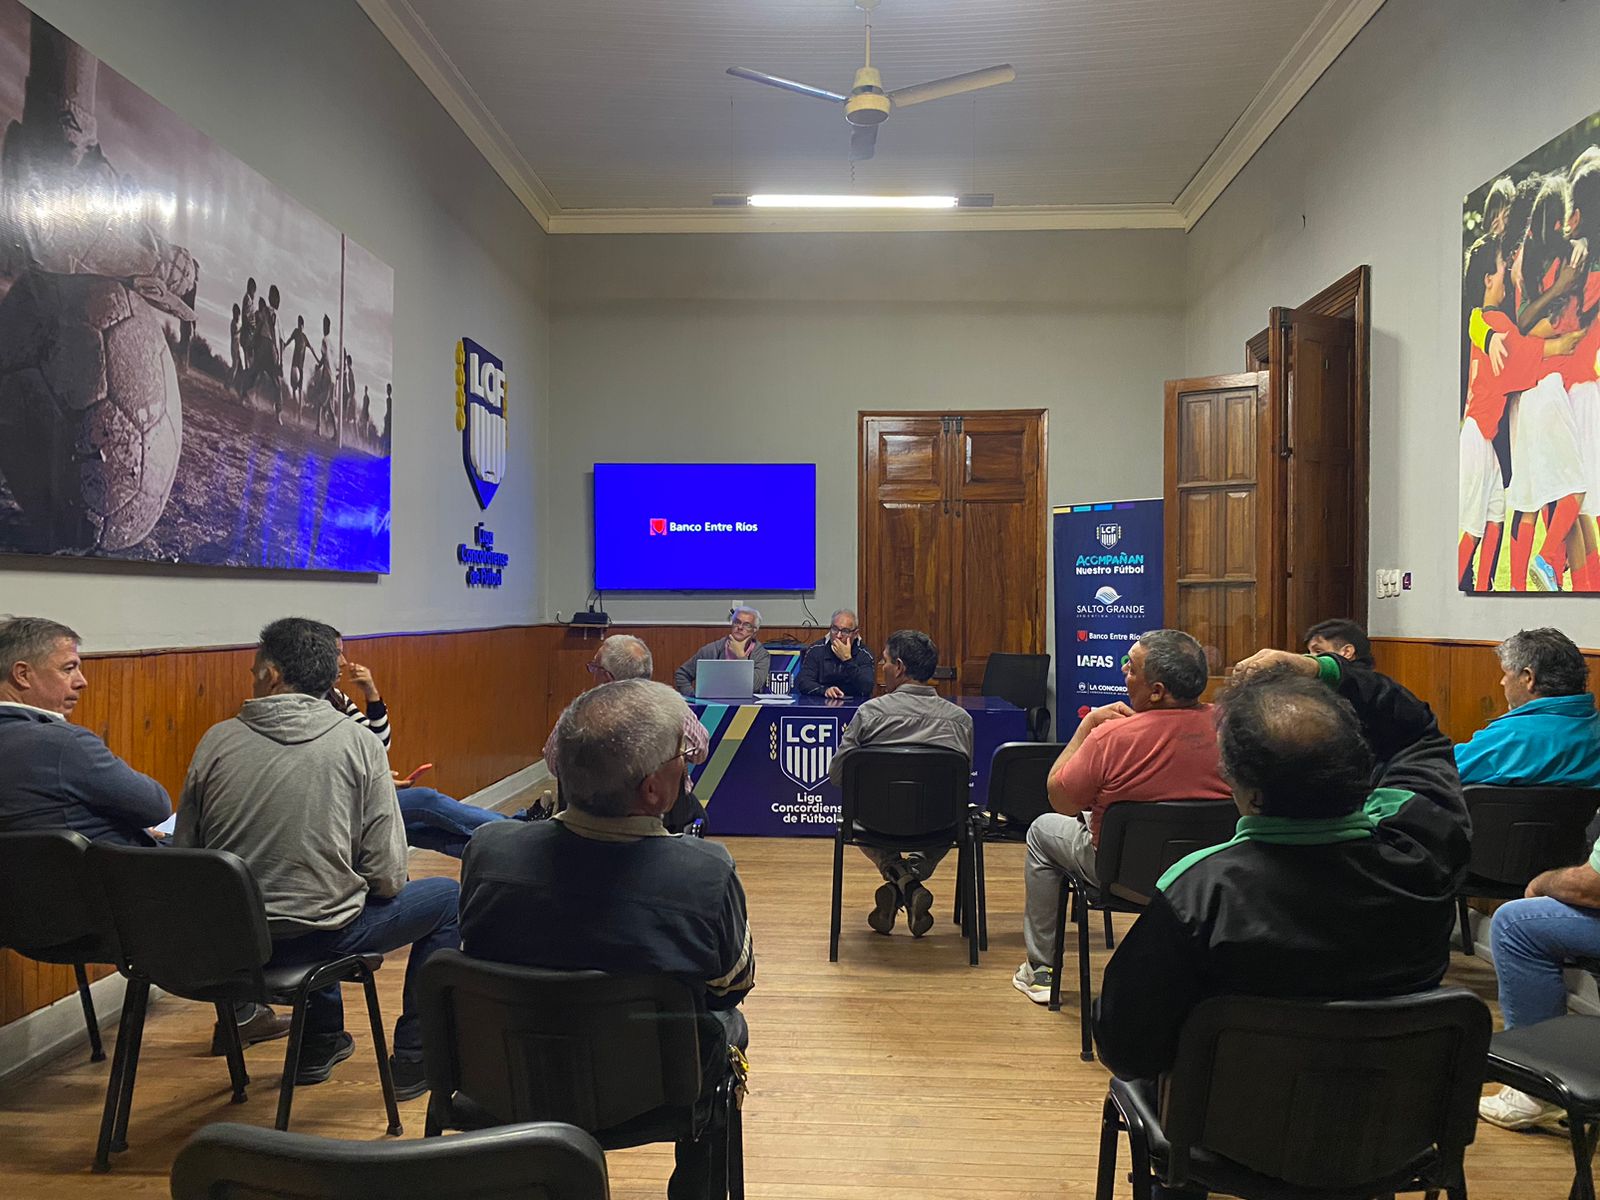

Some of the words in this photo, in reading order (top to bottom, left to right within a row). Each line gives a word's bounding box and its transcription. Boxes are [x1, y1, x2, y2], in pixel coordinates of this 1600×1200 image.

[469, 352, 506, 409] LCF
[669, 521, 702, 532] Banco
[704, 521, 733, 532] Entre
[735, 521, 759, 532] Ríos
[1101, 526, 1117, 534] LCF
[1075, 567, 1112, 575] Nuestro
[1113, 565, 1144, 574] Fútbol
[1076, 605, 1104, 614] SALTO
[1105, 605, 1145, 614] GRANDE
[1088, 632, 1109, 640] Banco
[1129, 633, 1141, 641] Río
[1077, 655, 1114, 668] IAFAS
[771, 673, 789, 682] LCF
[786, 724, 833, 744] LCF
[797, 792, 823, 804] Liga
[771, 803, 842, 813] Concordiens
[783, 814, 798, 823] de
[800, 813, 837, 823] Fútbol
